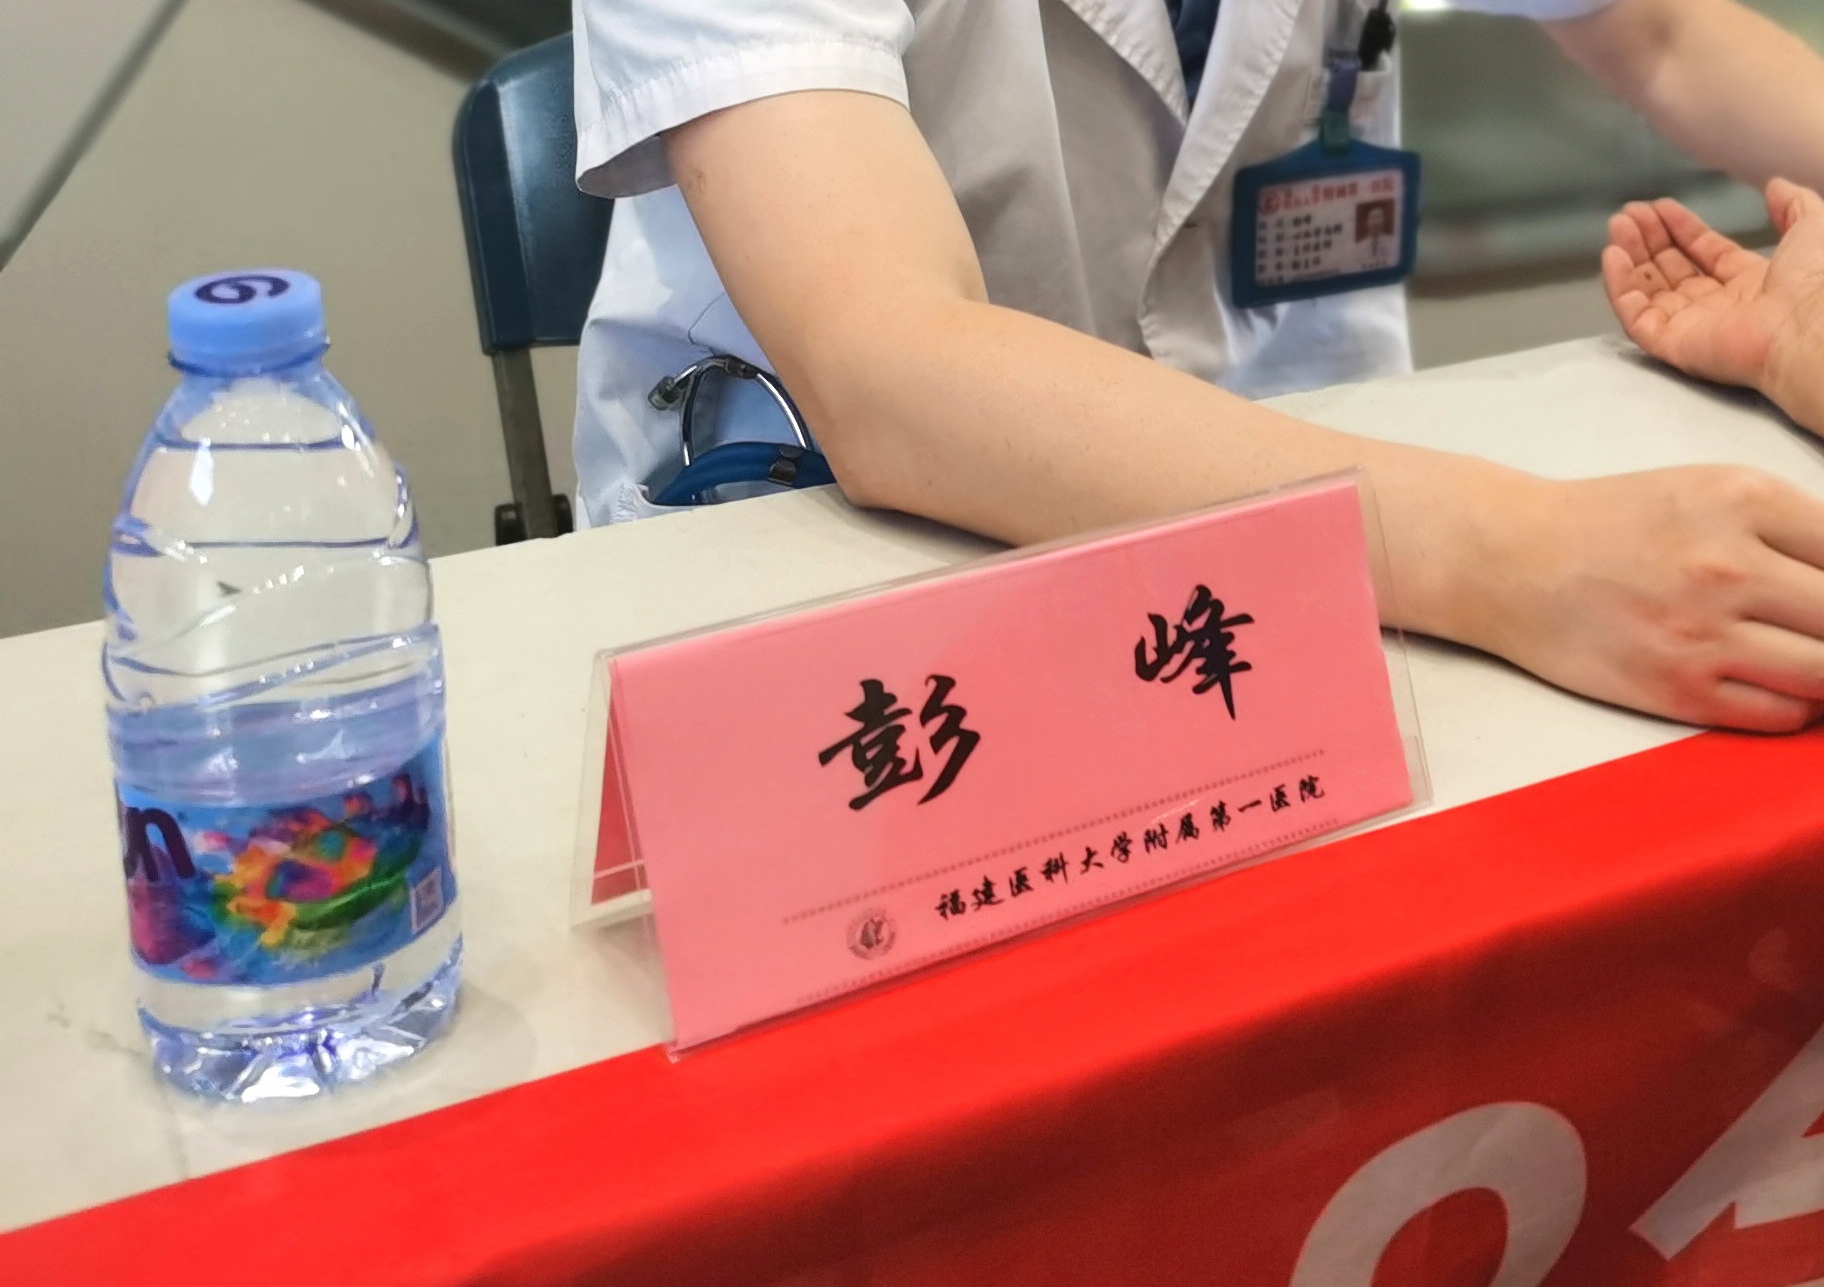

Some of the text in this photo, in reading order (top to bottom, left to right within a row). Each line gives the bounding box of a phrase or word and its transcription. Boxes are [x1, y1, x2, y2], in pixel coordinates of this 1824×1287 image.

[934, 774, 1326, 921] 福建医科大学附属第一医院
